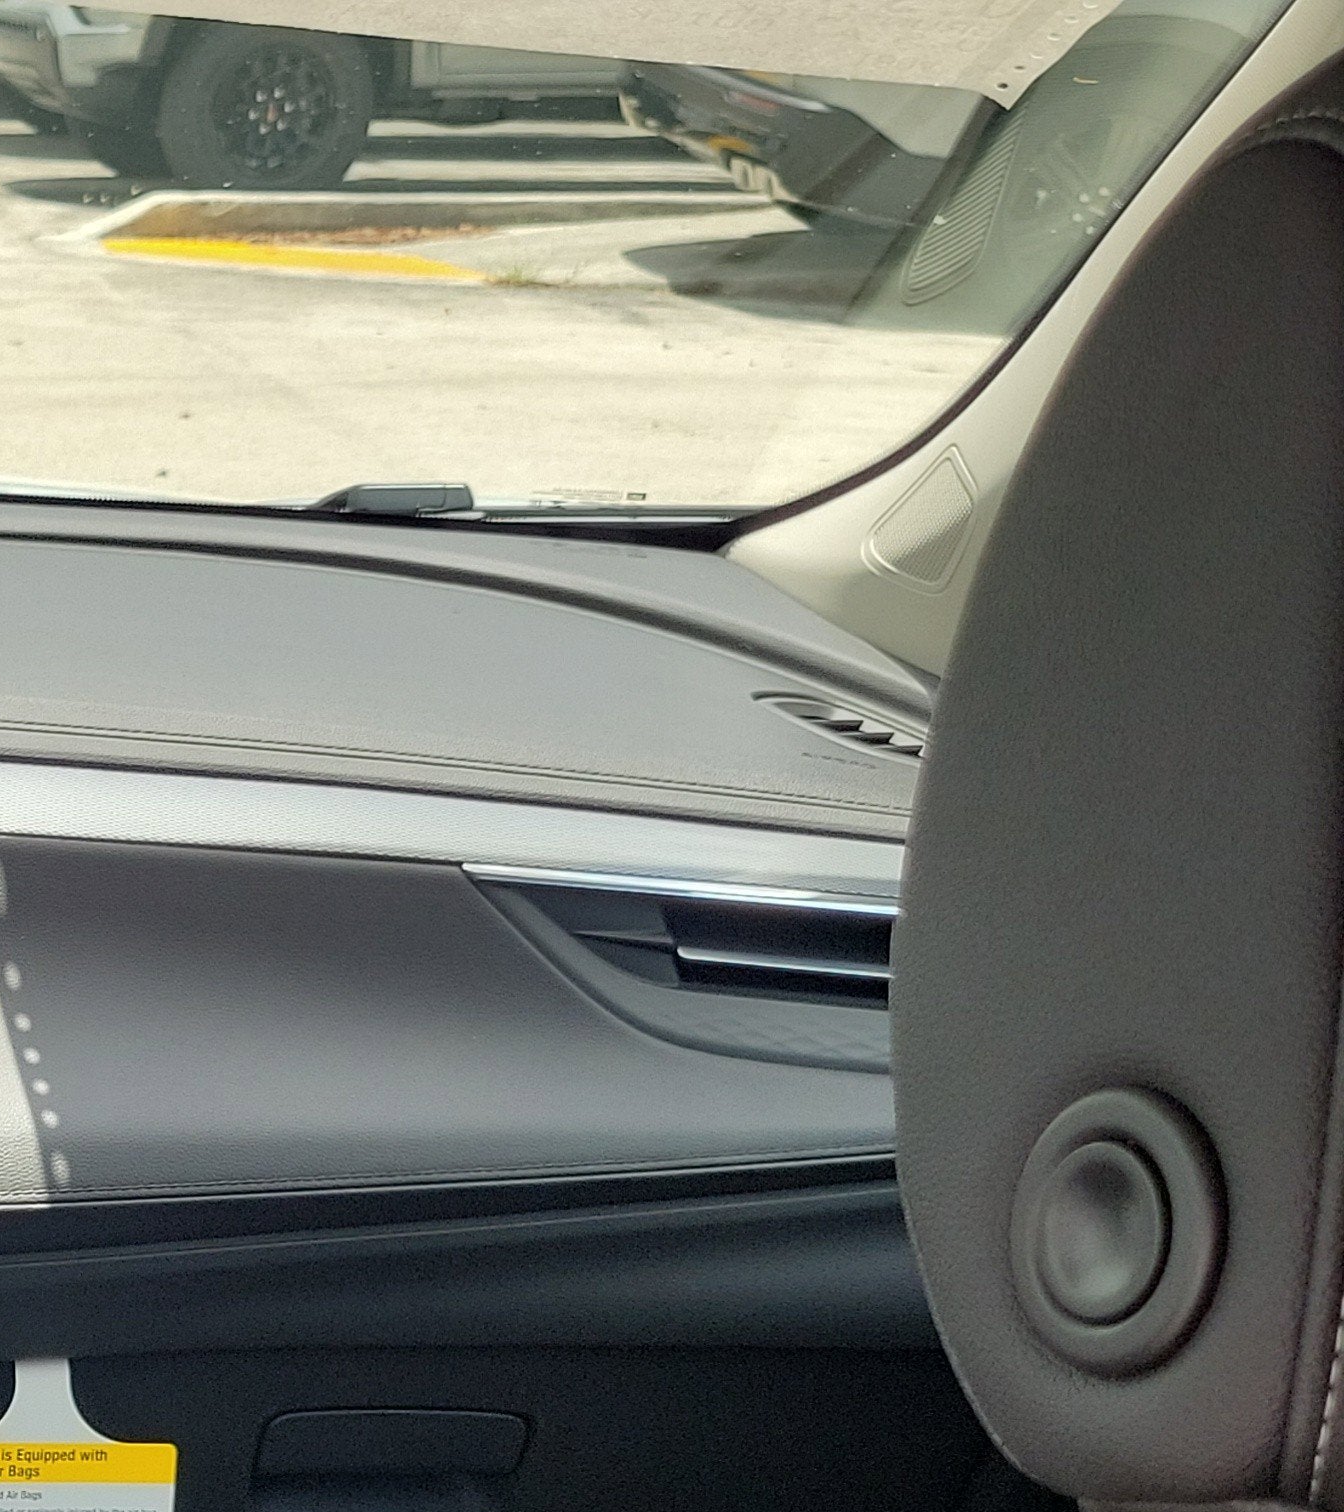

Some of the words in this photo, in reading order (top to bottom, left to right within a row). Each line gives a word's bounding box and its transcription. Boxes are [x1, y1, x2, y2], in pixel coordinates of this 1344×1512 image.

[1, 1450, 13, 1462] is
[16, 1449, 76, 1465] Equipped
[80, 1449, 108, 1462] with
[8, 1465, 41, 1480] Bags
[6, 1490, 19, 1500] Air
[21, 1490, 43, 1501] Bags
